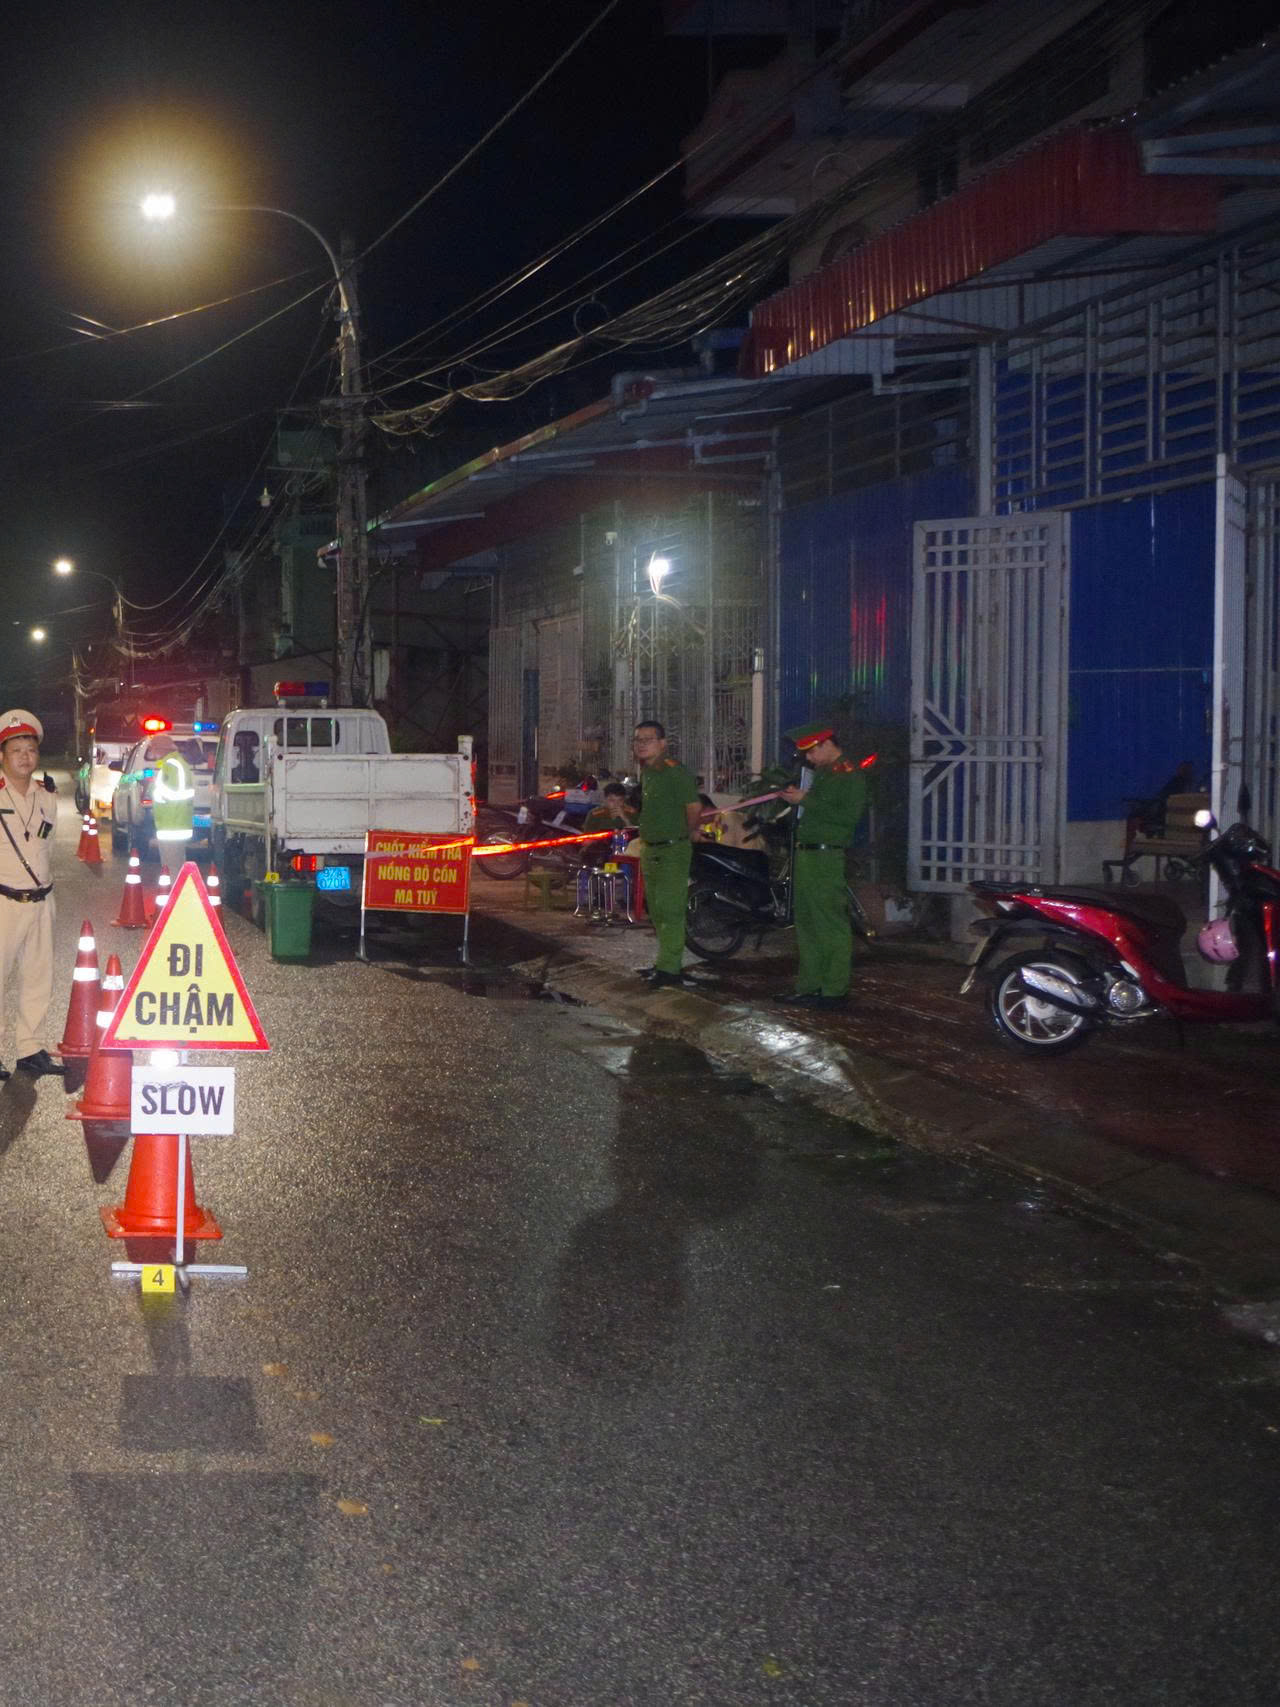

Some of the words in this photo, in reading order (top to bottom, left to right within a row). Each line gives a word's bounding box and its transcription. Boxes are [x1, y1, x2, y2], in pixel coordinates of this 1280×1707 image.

[414, 864, 430, 885] ĐỘ
[394, 888, 413, 905] MA
[167, 943, 204, 977] ĐI
[135, 983, 235, 1034] CHẬM
[141, 1084, 225, 1116] SLOW
[151, 1268, 165, 1286] 4
